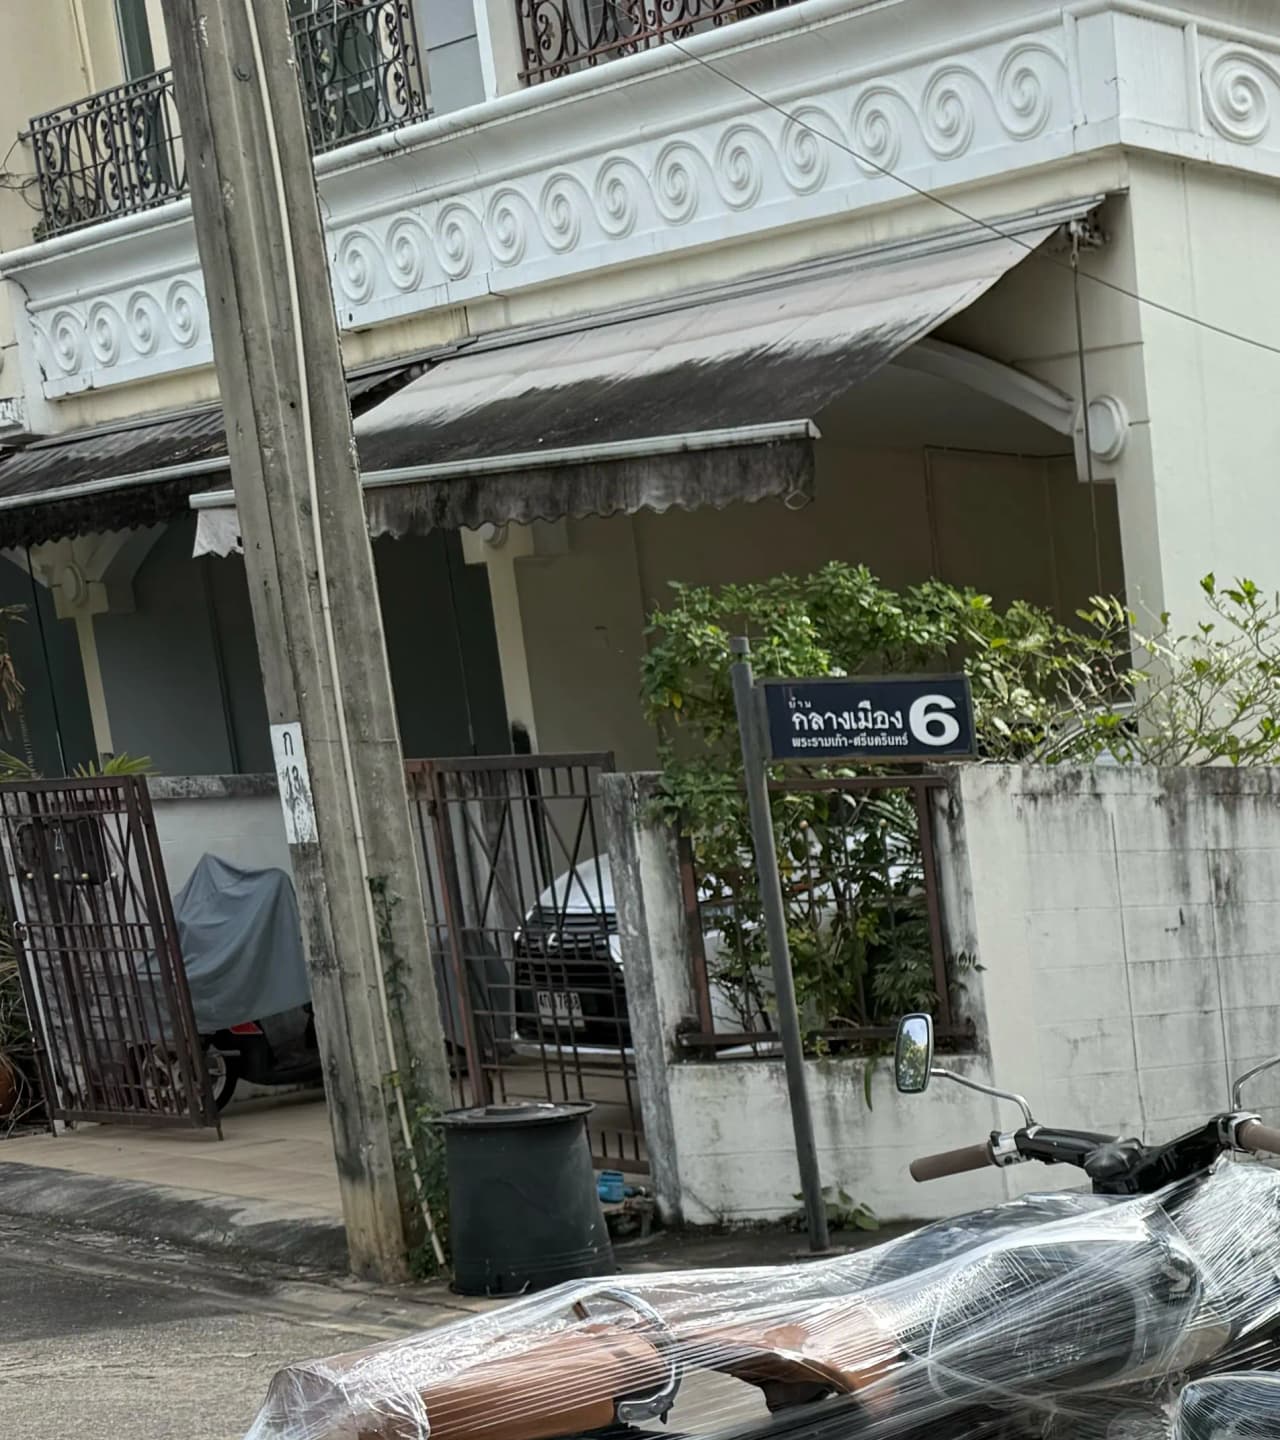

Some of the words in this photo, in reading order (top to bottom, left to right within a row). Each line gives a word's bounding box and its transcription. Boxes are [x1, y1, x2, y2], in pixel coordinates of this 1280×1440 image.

[792, 701, 903, 730] กลางเมือง
[909, 694, 960, 746] 6
